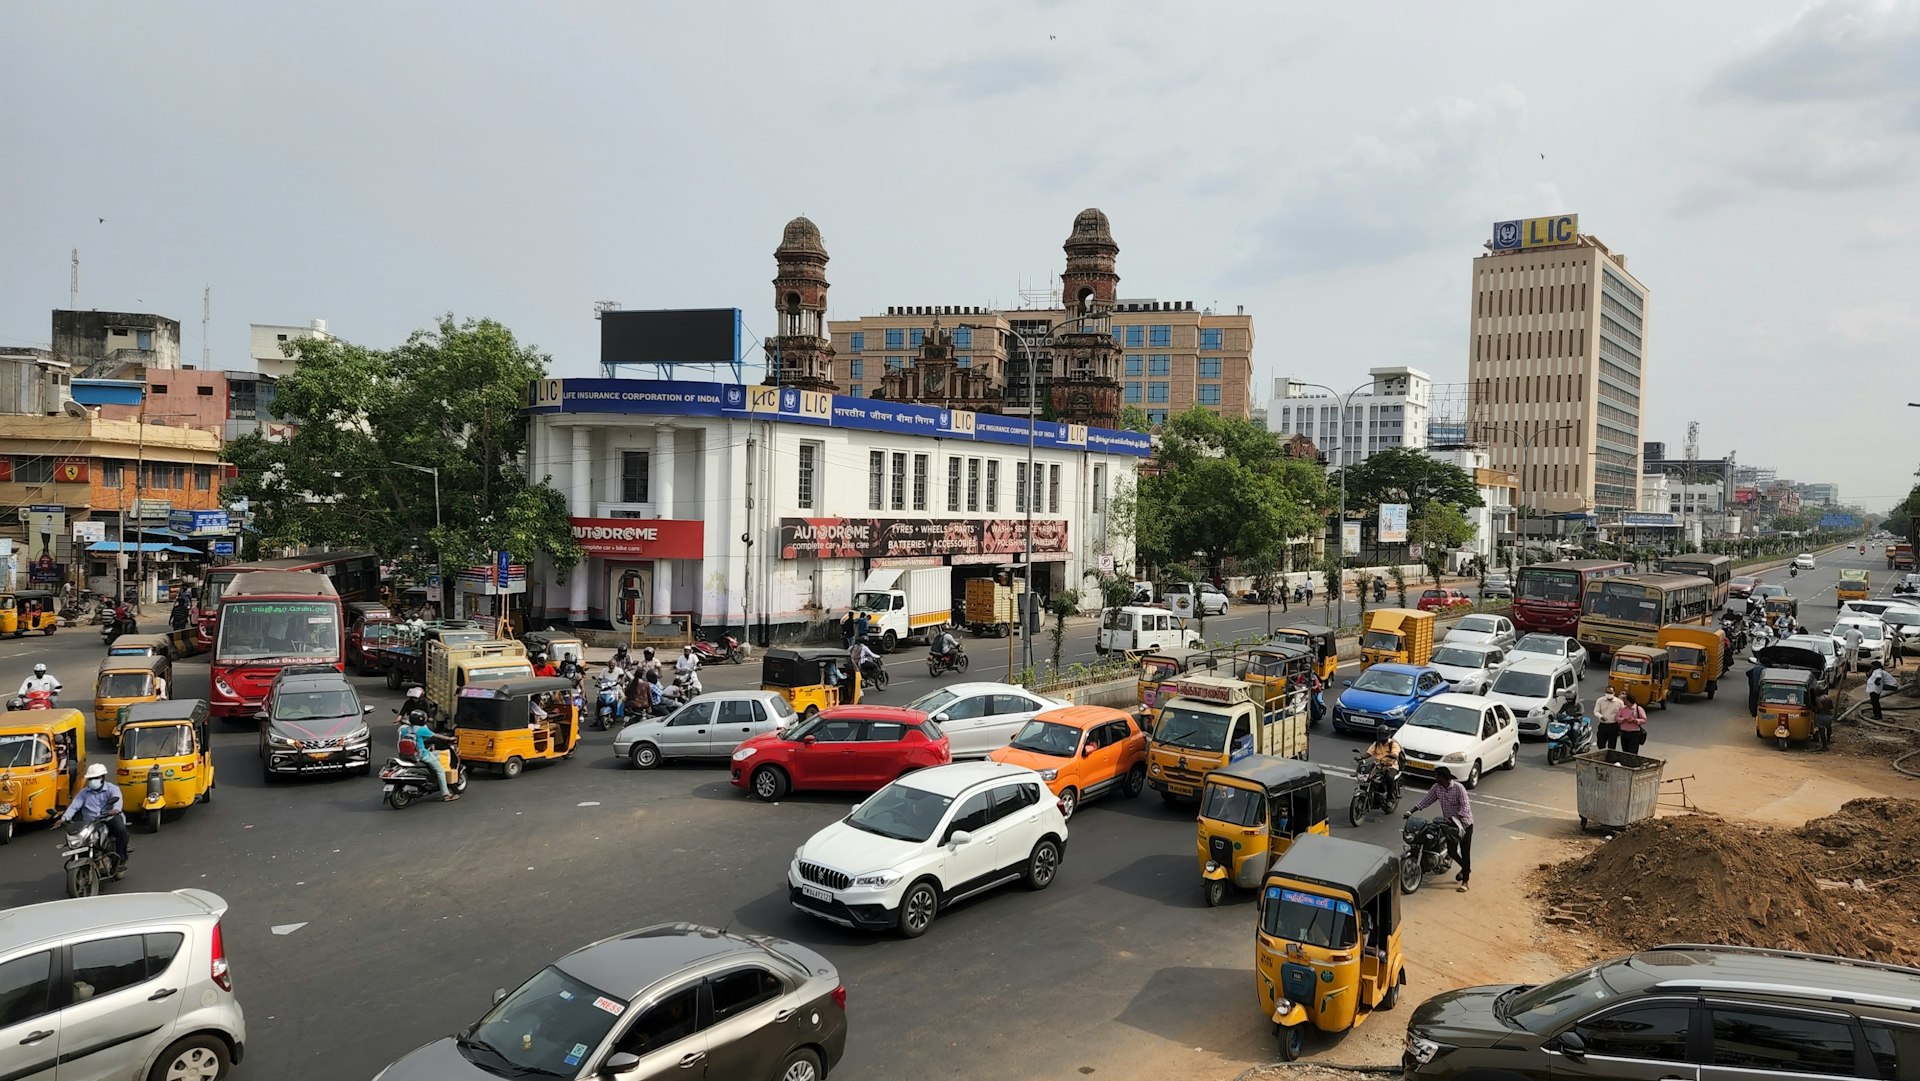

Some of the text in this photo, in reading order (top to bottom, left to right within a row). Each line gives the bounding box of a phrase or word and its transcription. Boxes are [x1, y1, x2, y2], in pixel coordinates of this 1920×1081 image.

[1530, 217, 1572, 244] LIC
[540, 380, 558, 401] LIC
[563, 391, 720, 403] LIFE INSURANCE CORPORATION OF INDIA
[752, 390, 776, 407] LIC
[805, 393, 827, 414] LIC
[834, 407, 935, 426] भारतीय जीवन बीमा निगम
[955, 411, 972, 431] LIC
[986, 425, 1009, 434] INSURANCE
[1010, 427, 1038, 437] CORPORAON
[1071, 426, 1085, 442] LIC
[892, 525, 974, 534] TYRES WHEELS PARTS
[991, 524, 1009, 533] WASH
[616, 544, 627, 552] bike
[793, 540, 869, 551] complete car bike care
[888, 539, 976, 549] BATTERIES ACCESSORIES
[232, 605, 239, 613] A
[241, 605, 246, 613] 1
[597, 999, 622, 1014] PRESS
